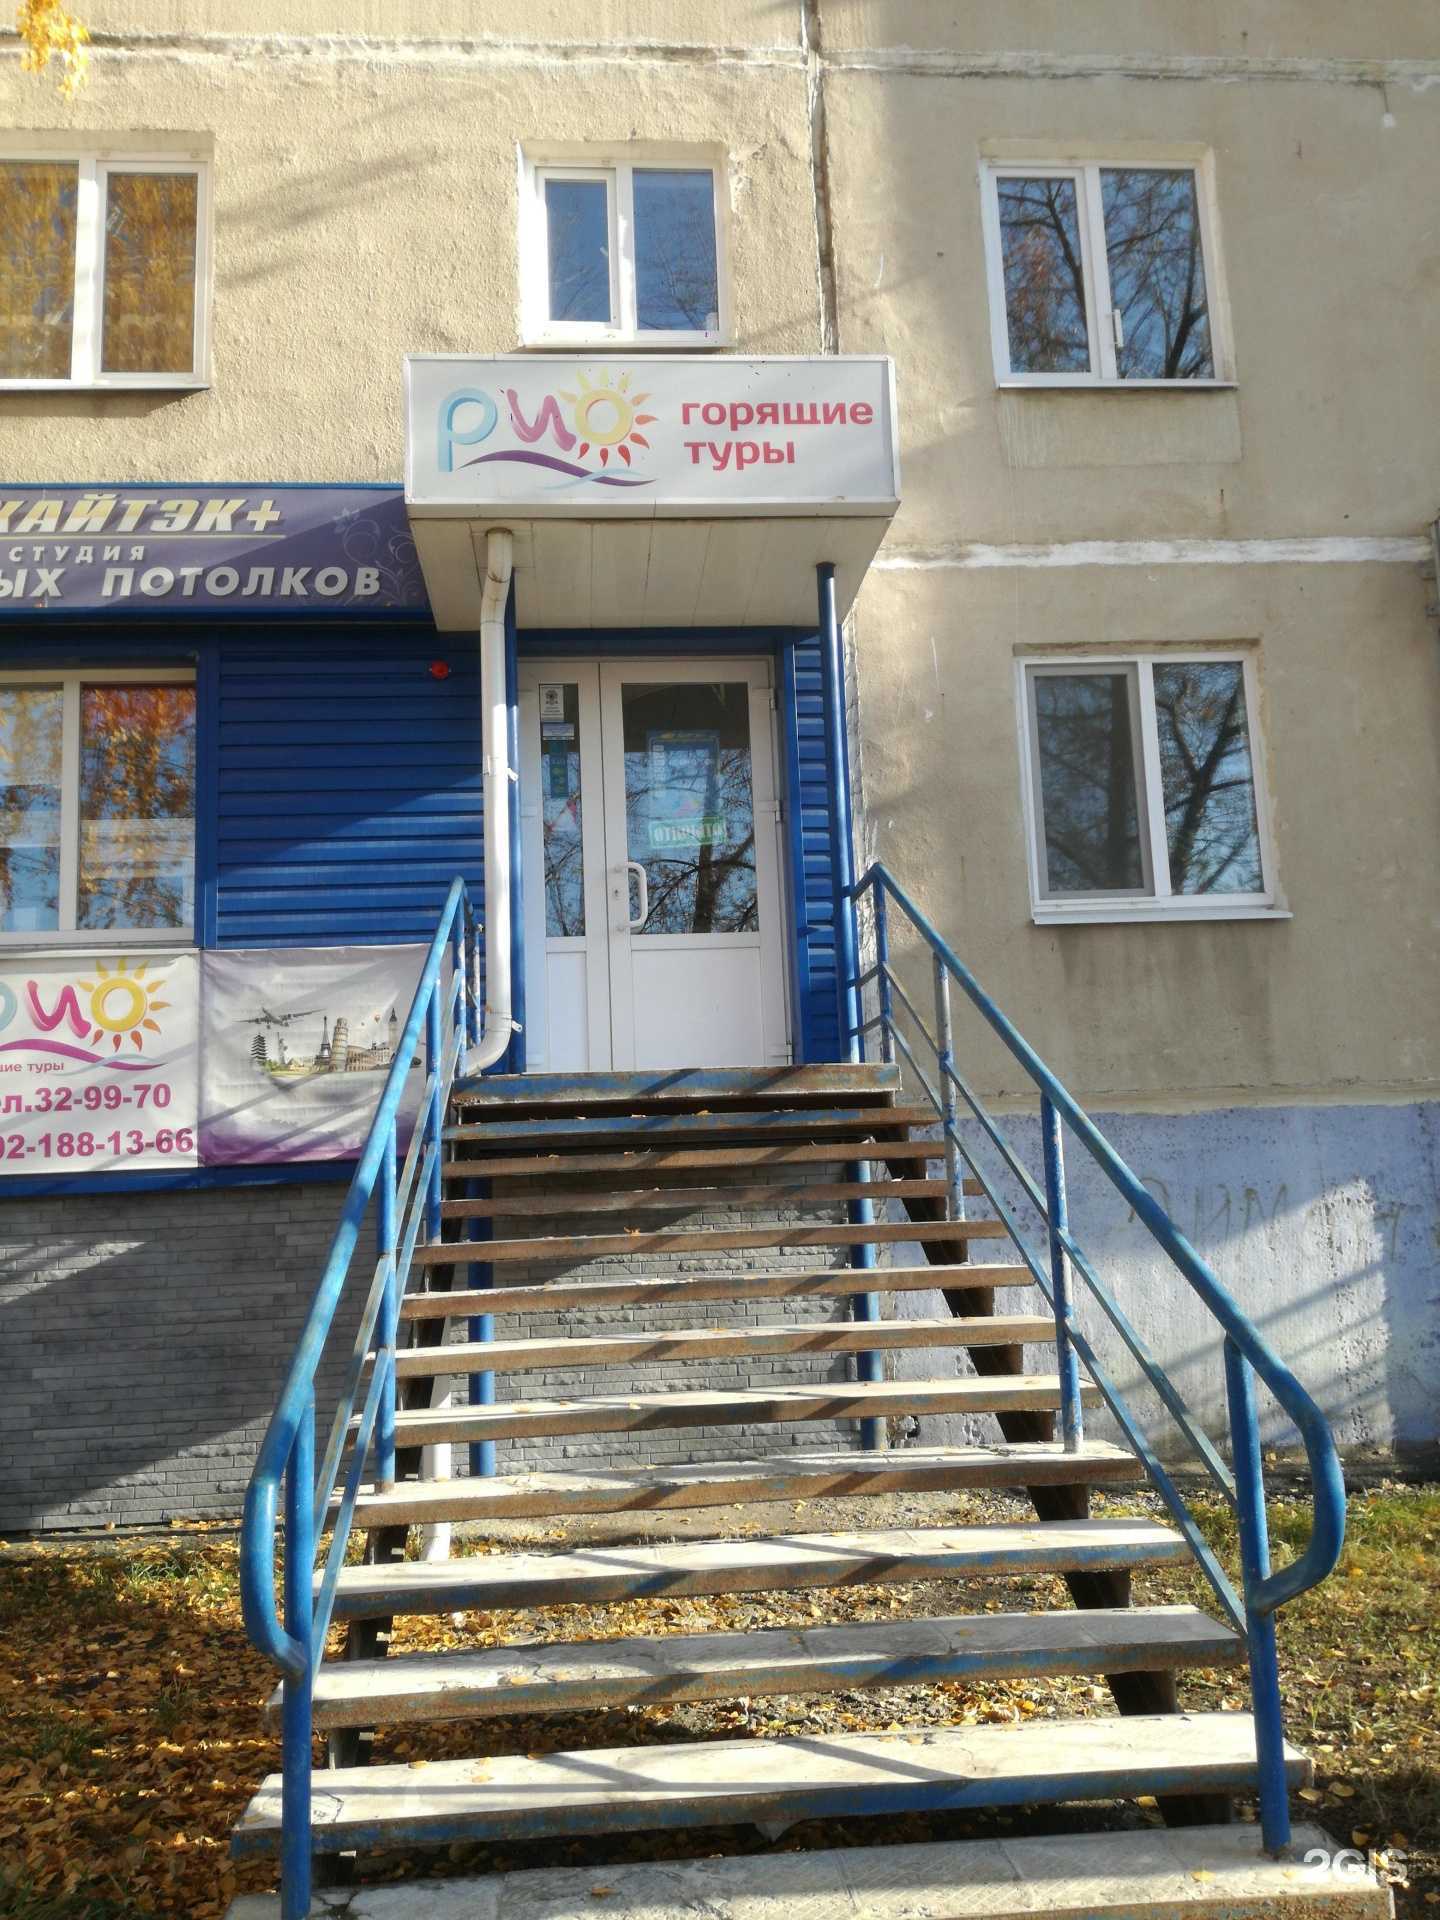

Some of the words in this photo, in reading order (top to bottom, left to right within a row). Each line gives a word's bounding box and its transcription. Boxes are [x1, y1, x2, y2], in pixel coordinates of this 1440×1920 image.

[682, 402, 874, 431] горящие
[684, 441, 795, 471] туры
[9, 545, 145, 564] СТУДИЯ
[102, 566, 381, 597] ПОТОЛКОВ
[27, 1062, 65, 1073] туры
[0, 1083, 171, 1113] л.32-99-70
